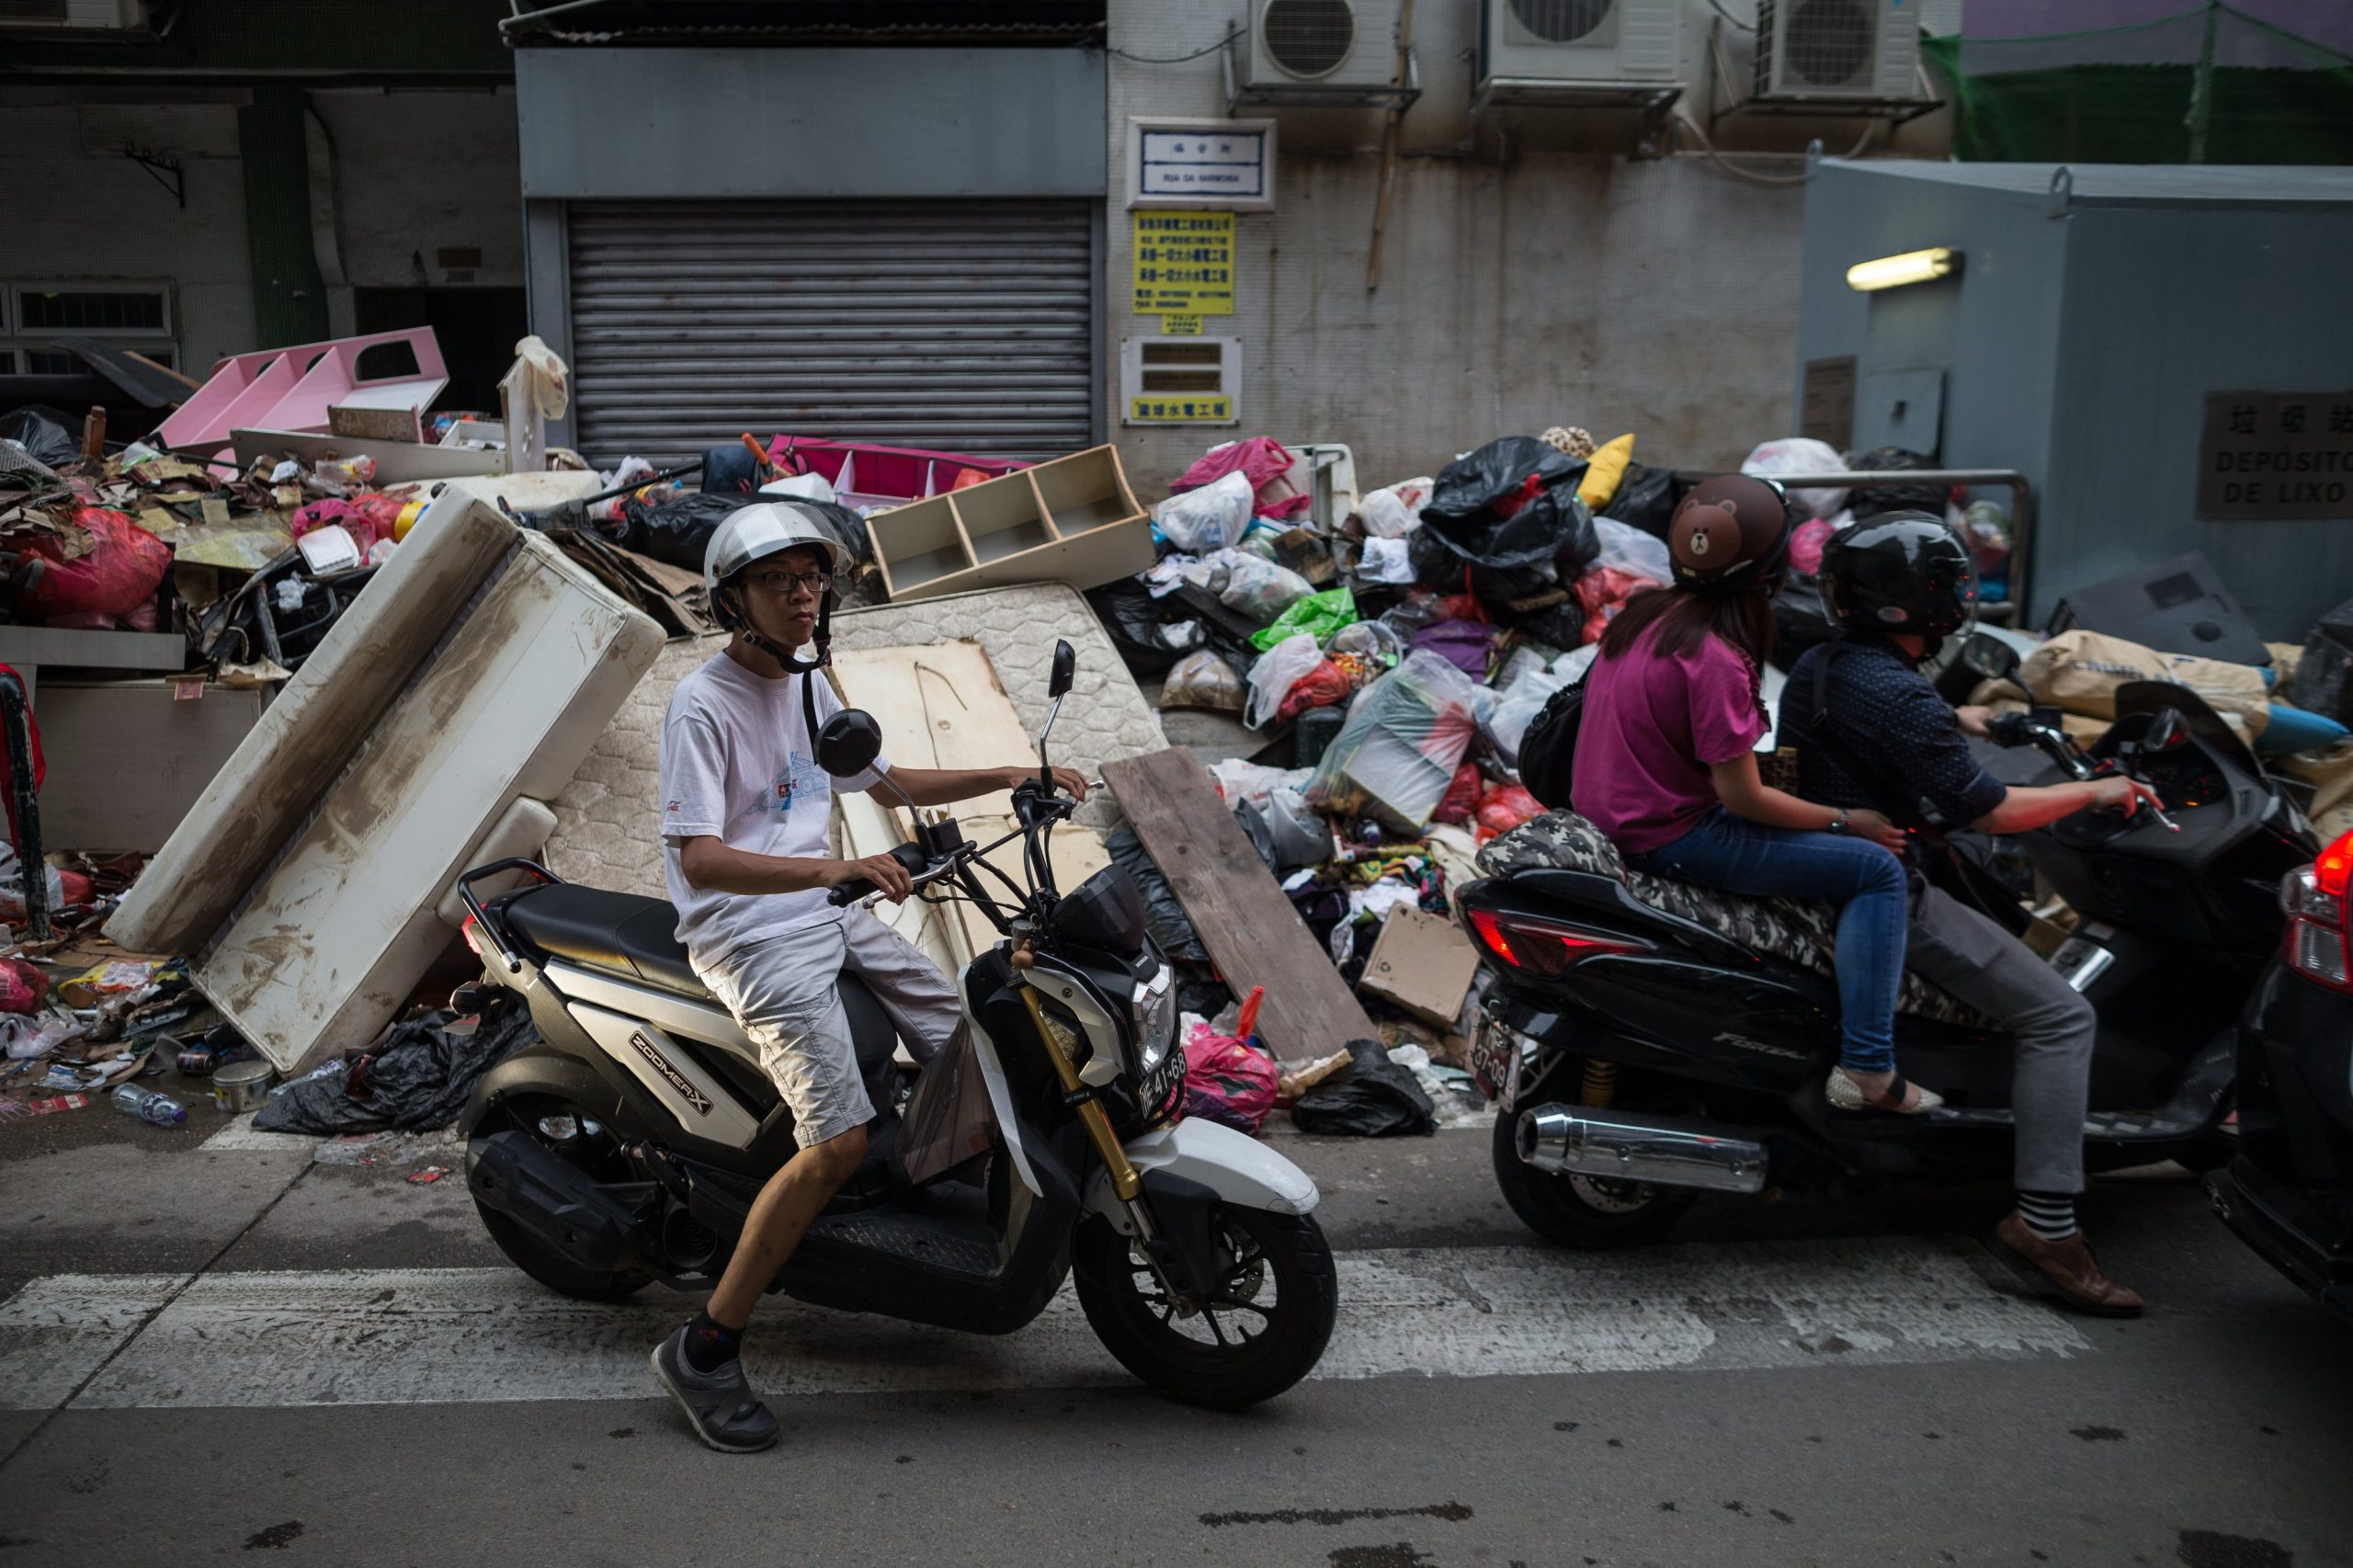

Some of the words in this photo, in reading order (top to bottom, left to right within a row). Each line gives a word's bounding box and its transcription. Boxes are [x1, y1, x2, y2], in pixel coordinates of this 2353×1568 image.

[1162, 173, 1179, 183] RUA
[1183, 173, 1195, 183] DA
[2227, 404, 2353, 435] 垃圾站
[2223, 482, 2263, 505] DE
[2278, 481, 2347, 505] LIXO
[1474, 1043, 1506, 1088] 37-09
